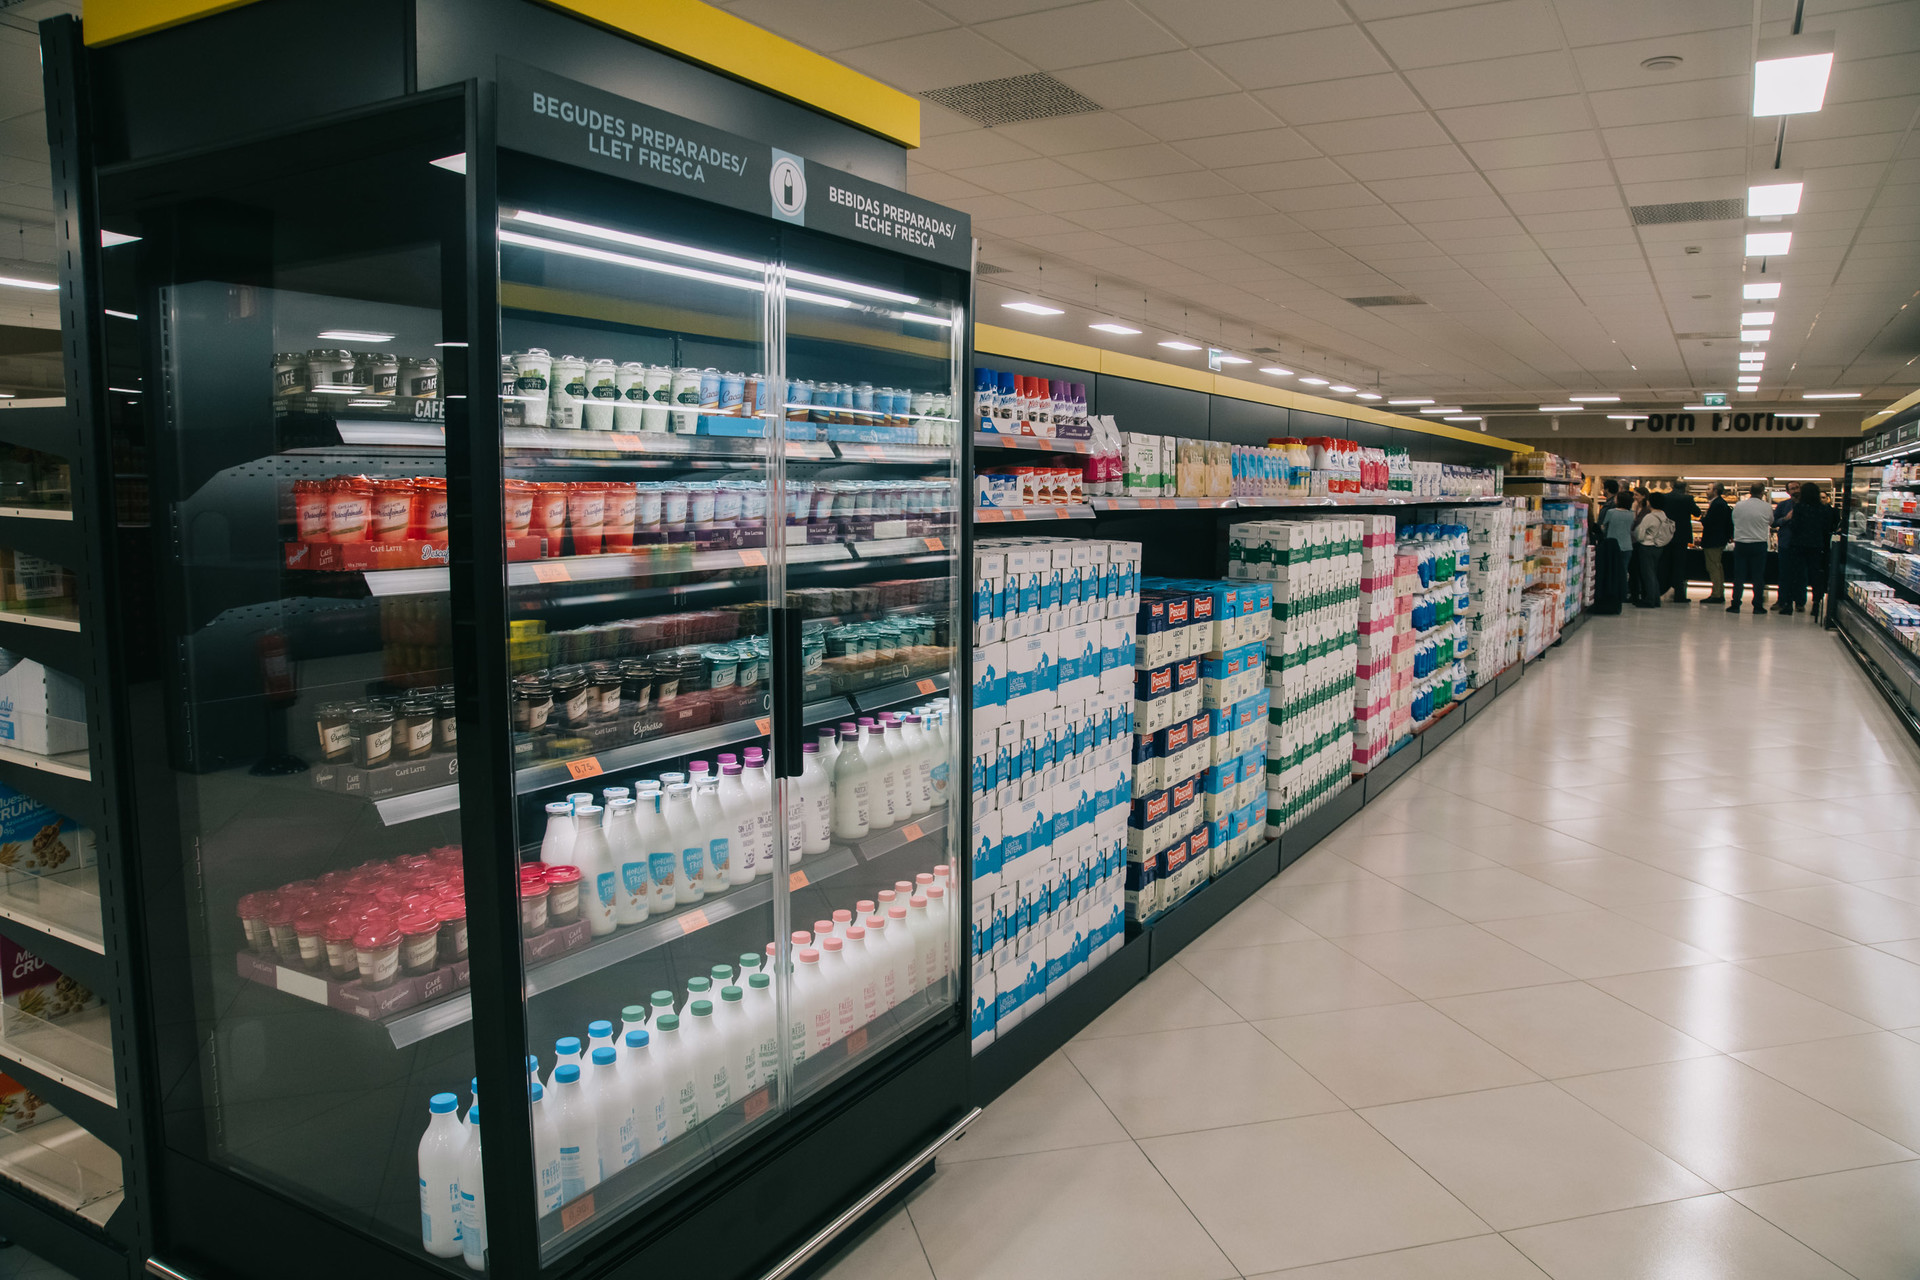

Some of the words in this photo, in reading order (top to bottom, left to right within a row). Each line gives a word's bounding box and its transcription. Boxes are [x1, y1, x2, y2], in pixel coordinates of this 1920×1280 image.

[532, 92, 626, 138] BEGUDES
[631, 121, 748, 177] PREPARADES/
[588, 132, 633, 163] LLET
[638, 145, 706, 184] FRESCA
[828, 185, 880, 218] BEBIDAS
[882, 203, 957, 242] PREPARADAS/
[854, 211, 892, 238] LECHE
[894, 223, 936, 250] FRESCA
[370, 545, 385, 553] CAFÉ
[386, 544, 403, 552] LATTE
[1010, 676, 1024, 686] Leche
[1010, 682, 1027, 694] ENTERA
[633, 720, 664, 739] Espresso
[346, 774, 359, 783] CAFÉ
[395, 768, 410, 777] CAFÉ
[410, 765, 426, 774] LATTE
[346, 781, 361, 791] LATTE
[425, 975, 442, 990] CAFÉ
[424, 983, 443, 999] LATTE
